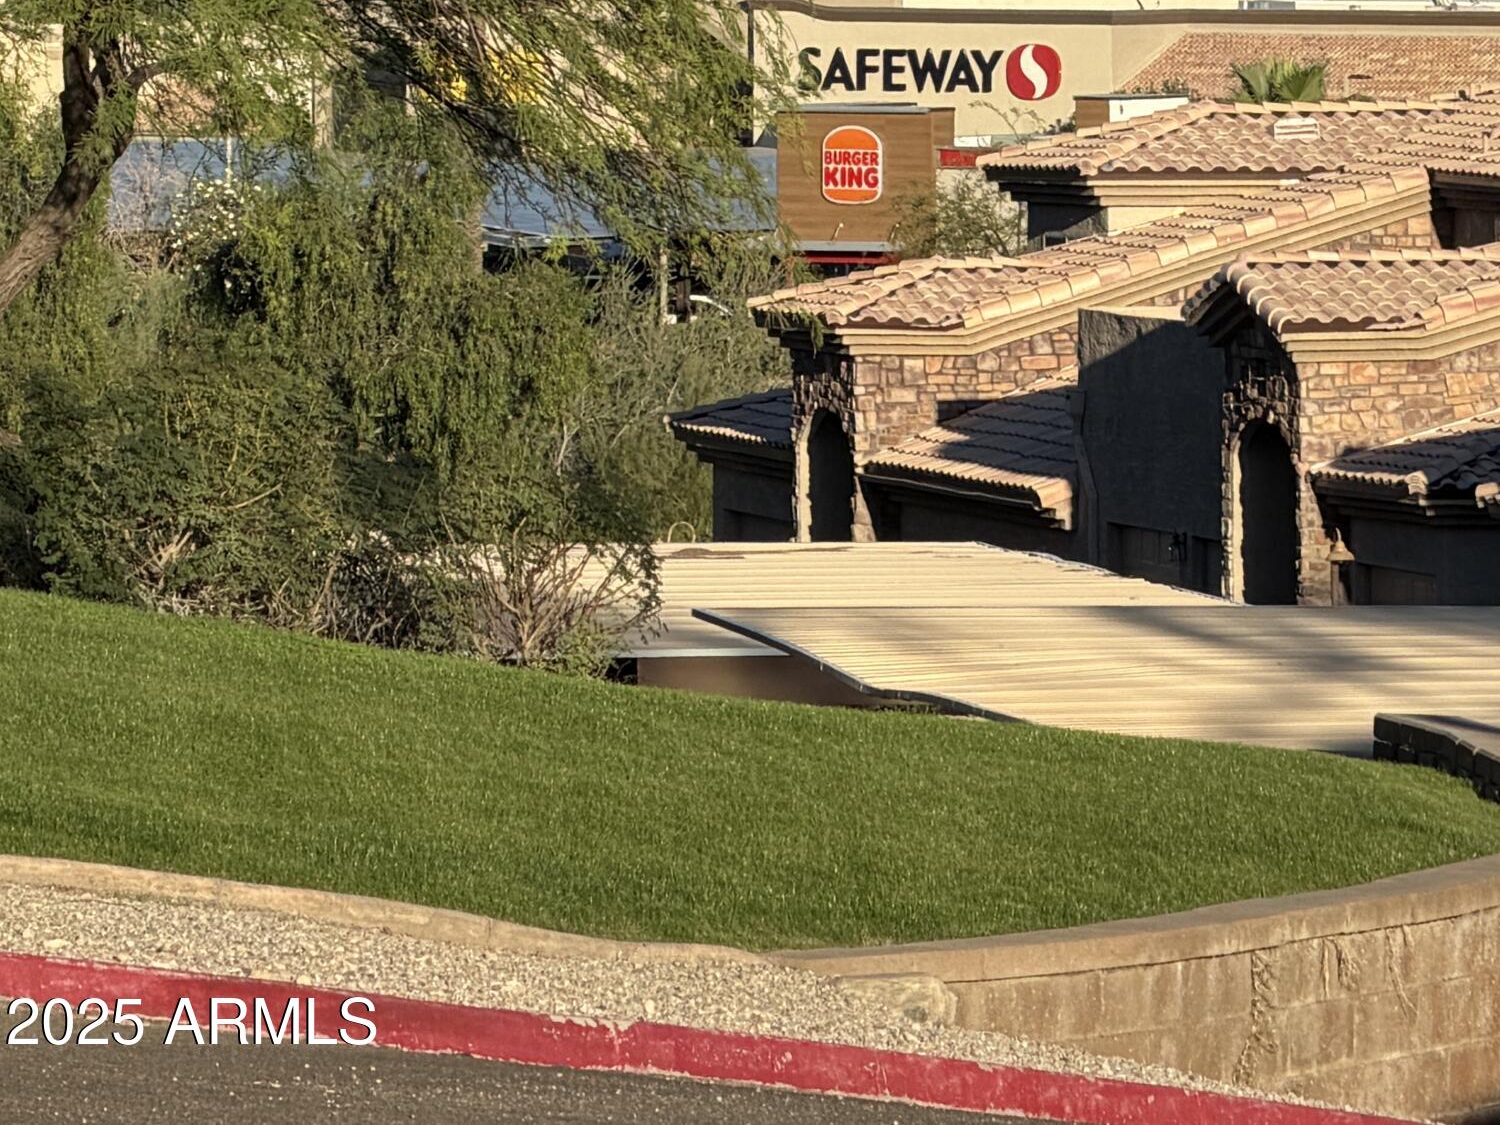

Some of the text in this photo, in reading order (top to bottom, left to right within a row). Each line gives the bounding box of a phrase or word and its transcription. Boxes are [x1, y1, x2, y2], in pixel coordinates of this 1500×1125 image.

[797, 46, 1004, 93] SAFEWAY
[824, 150, 879, 166] BURGER
[824, 166, 879, 188] KING
